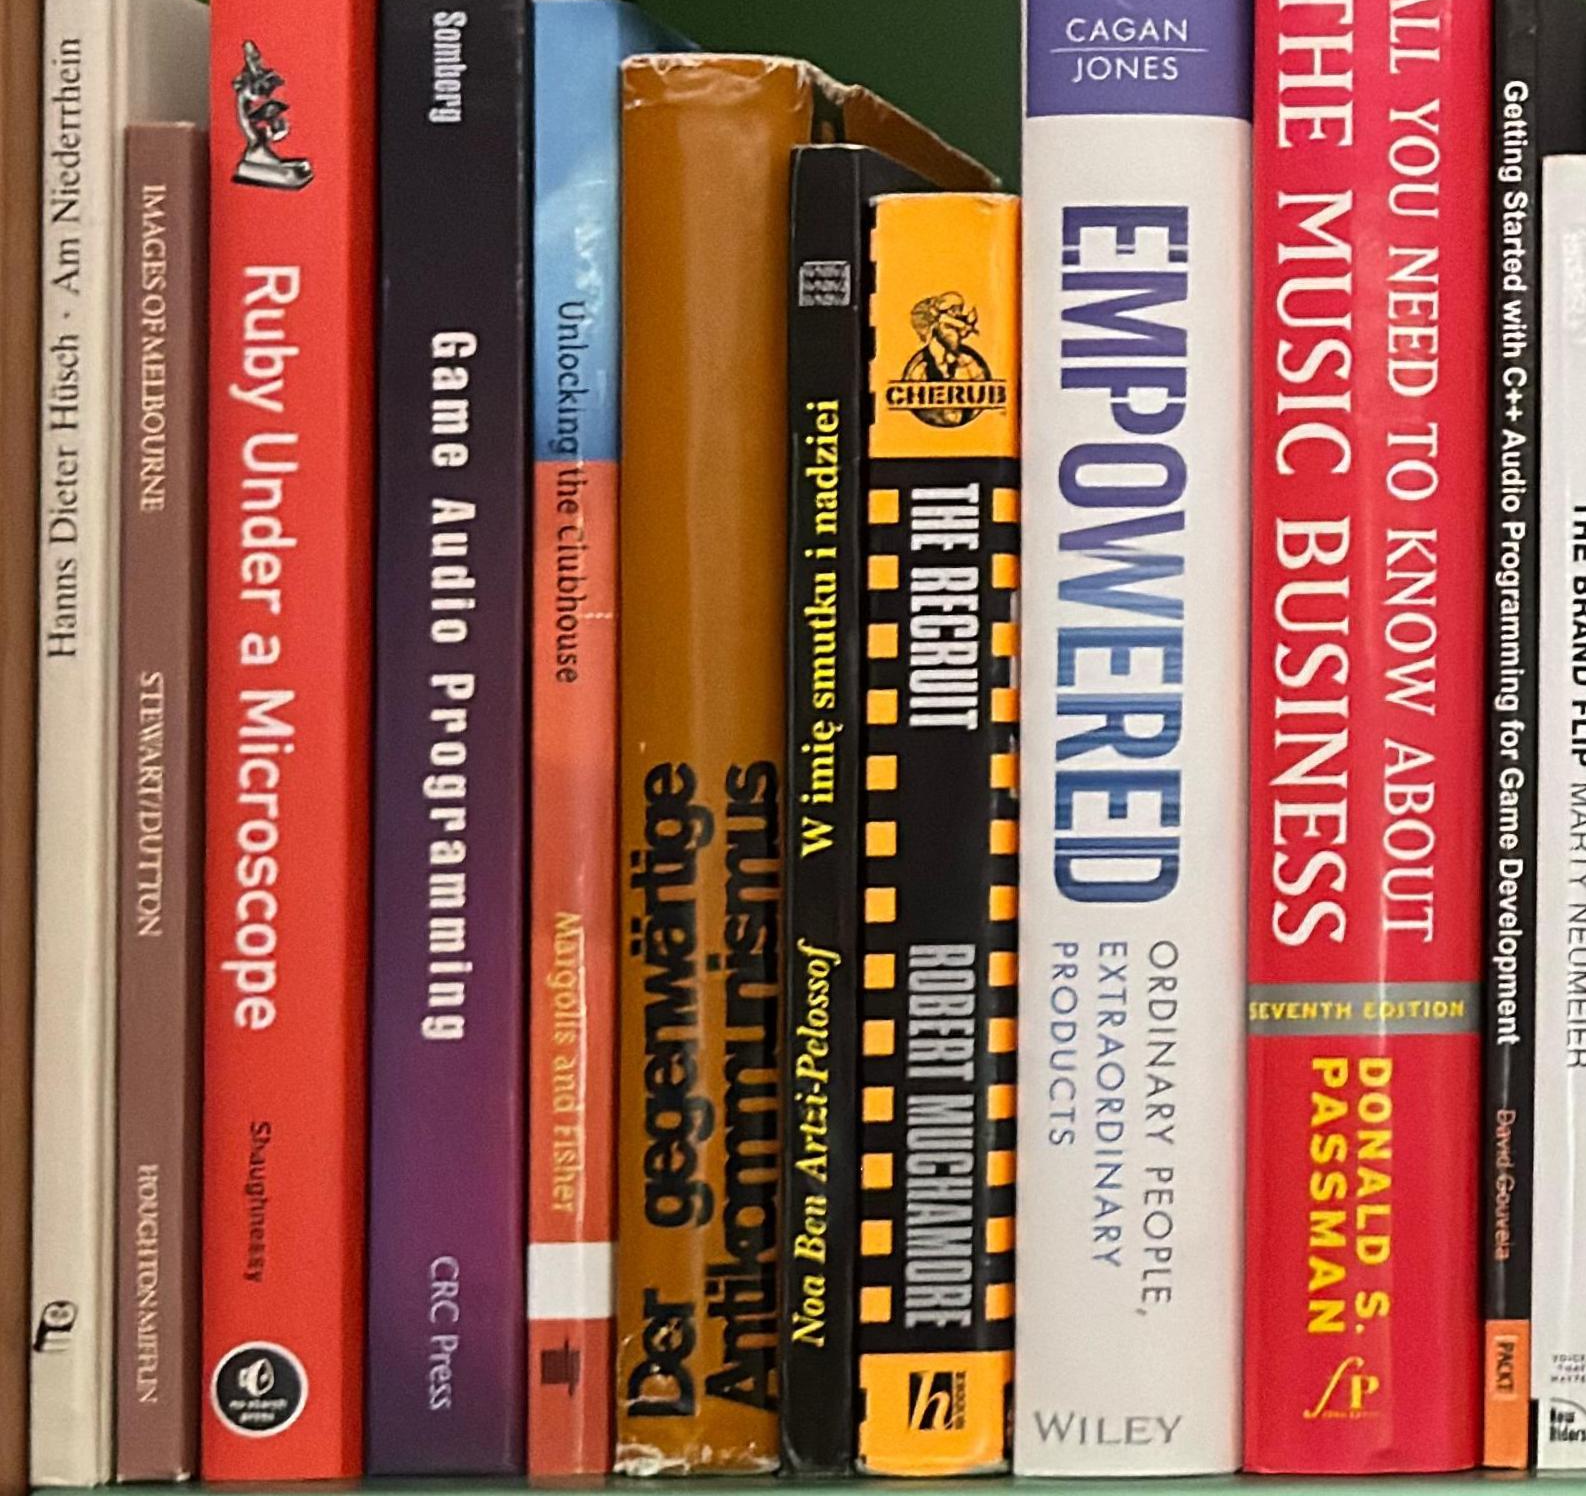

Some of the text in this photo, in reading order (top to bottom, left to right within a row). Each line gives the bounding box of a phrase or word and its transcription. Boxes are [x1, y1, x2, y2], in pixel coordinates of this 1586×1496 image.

[428, 10, 469, 124] Somberg
[1065, 17, 1188, 43] CAGAN
[1070, 55, 1180, 83] JONES
[1387, 97, 1441, 219] YOU
[48, 37, 82, 659] Hanns Dieter Hüsch Am Niederrhein
[139, 183, 167, 512] IMAGES OF MELBOURNE
[885, 385, 1007, 405] CHERUB
[1276, 188, 1353, 475] MUSIC
[1387, 245, 1439, 398] NEED
[548, 301, 588, 684] Unlocking the Clubhouse
[1054, 205, 1189, 904] EMPOWERED
[1386, 422, 1439, 502] TO
[1493, 79, 1529, 1046] Getting Started with C++ Audio Programming for Game Development
[220, 264, 300, 1031] Ruby Under a Microscope
[422, 331, 478, 1041] Game Audio Programming
[801, 399, 843, 855] W imię smutku i nadziei
[908, 482, 980, 731] THE RECRUIT
[1270, 514, 1352, 946] BUSINESS
[1384, 527, 1438, 716] KNOW
[1382, 737, 1437, 943] ABOUT
[546, 911, 586, 1213] Margolis and Fisher
[626, 761, 716, 1419] Der gegenwärtige
[705, 759, 779, 1411] Antikommunismus
[791, 937, 842, 1346] Noa Ben Artzi-Pelossof
[904, 943, 976, 1329] ROBERT MUCHAMORE
[1047, 941, 1080, 1147] PRODUCTS
[1091, 941, 1128, 1268] EXTRAORDINARY
[1135, 939, 1180, 1317] ORDINARY PEOPLE,
[1248, 999, 1466, 1021] SEVENTH EDITION
[1496, 1108, 1517, 1168] David
[242, 1120, 272, 1284] Shaughnessy
[428, 1255, 460, 1411] CRC Press
[1307, 1056, 1349, 1335] PASSMAN
[1355, 1056, 1394, 1335] DONALD S.
[1033, 1410, 1183, 1445] WILEY
